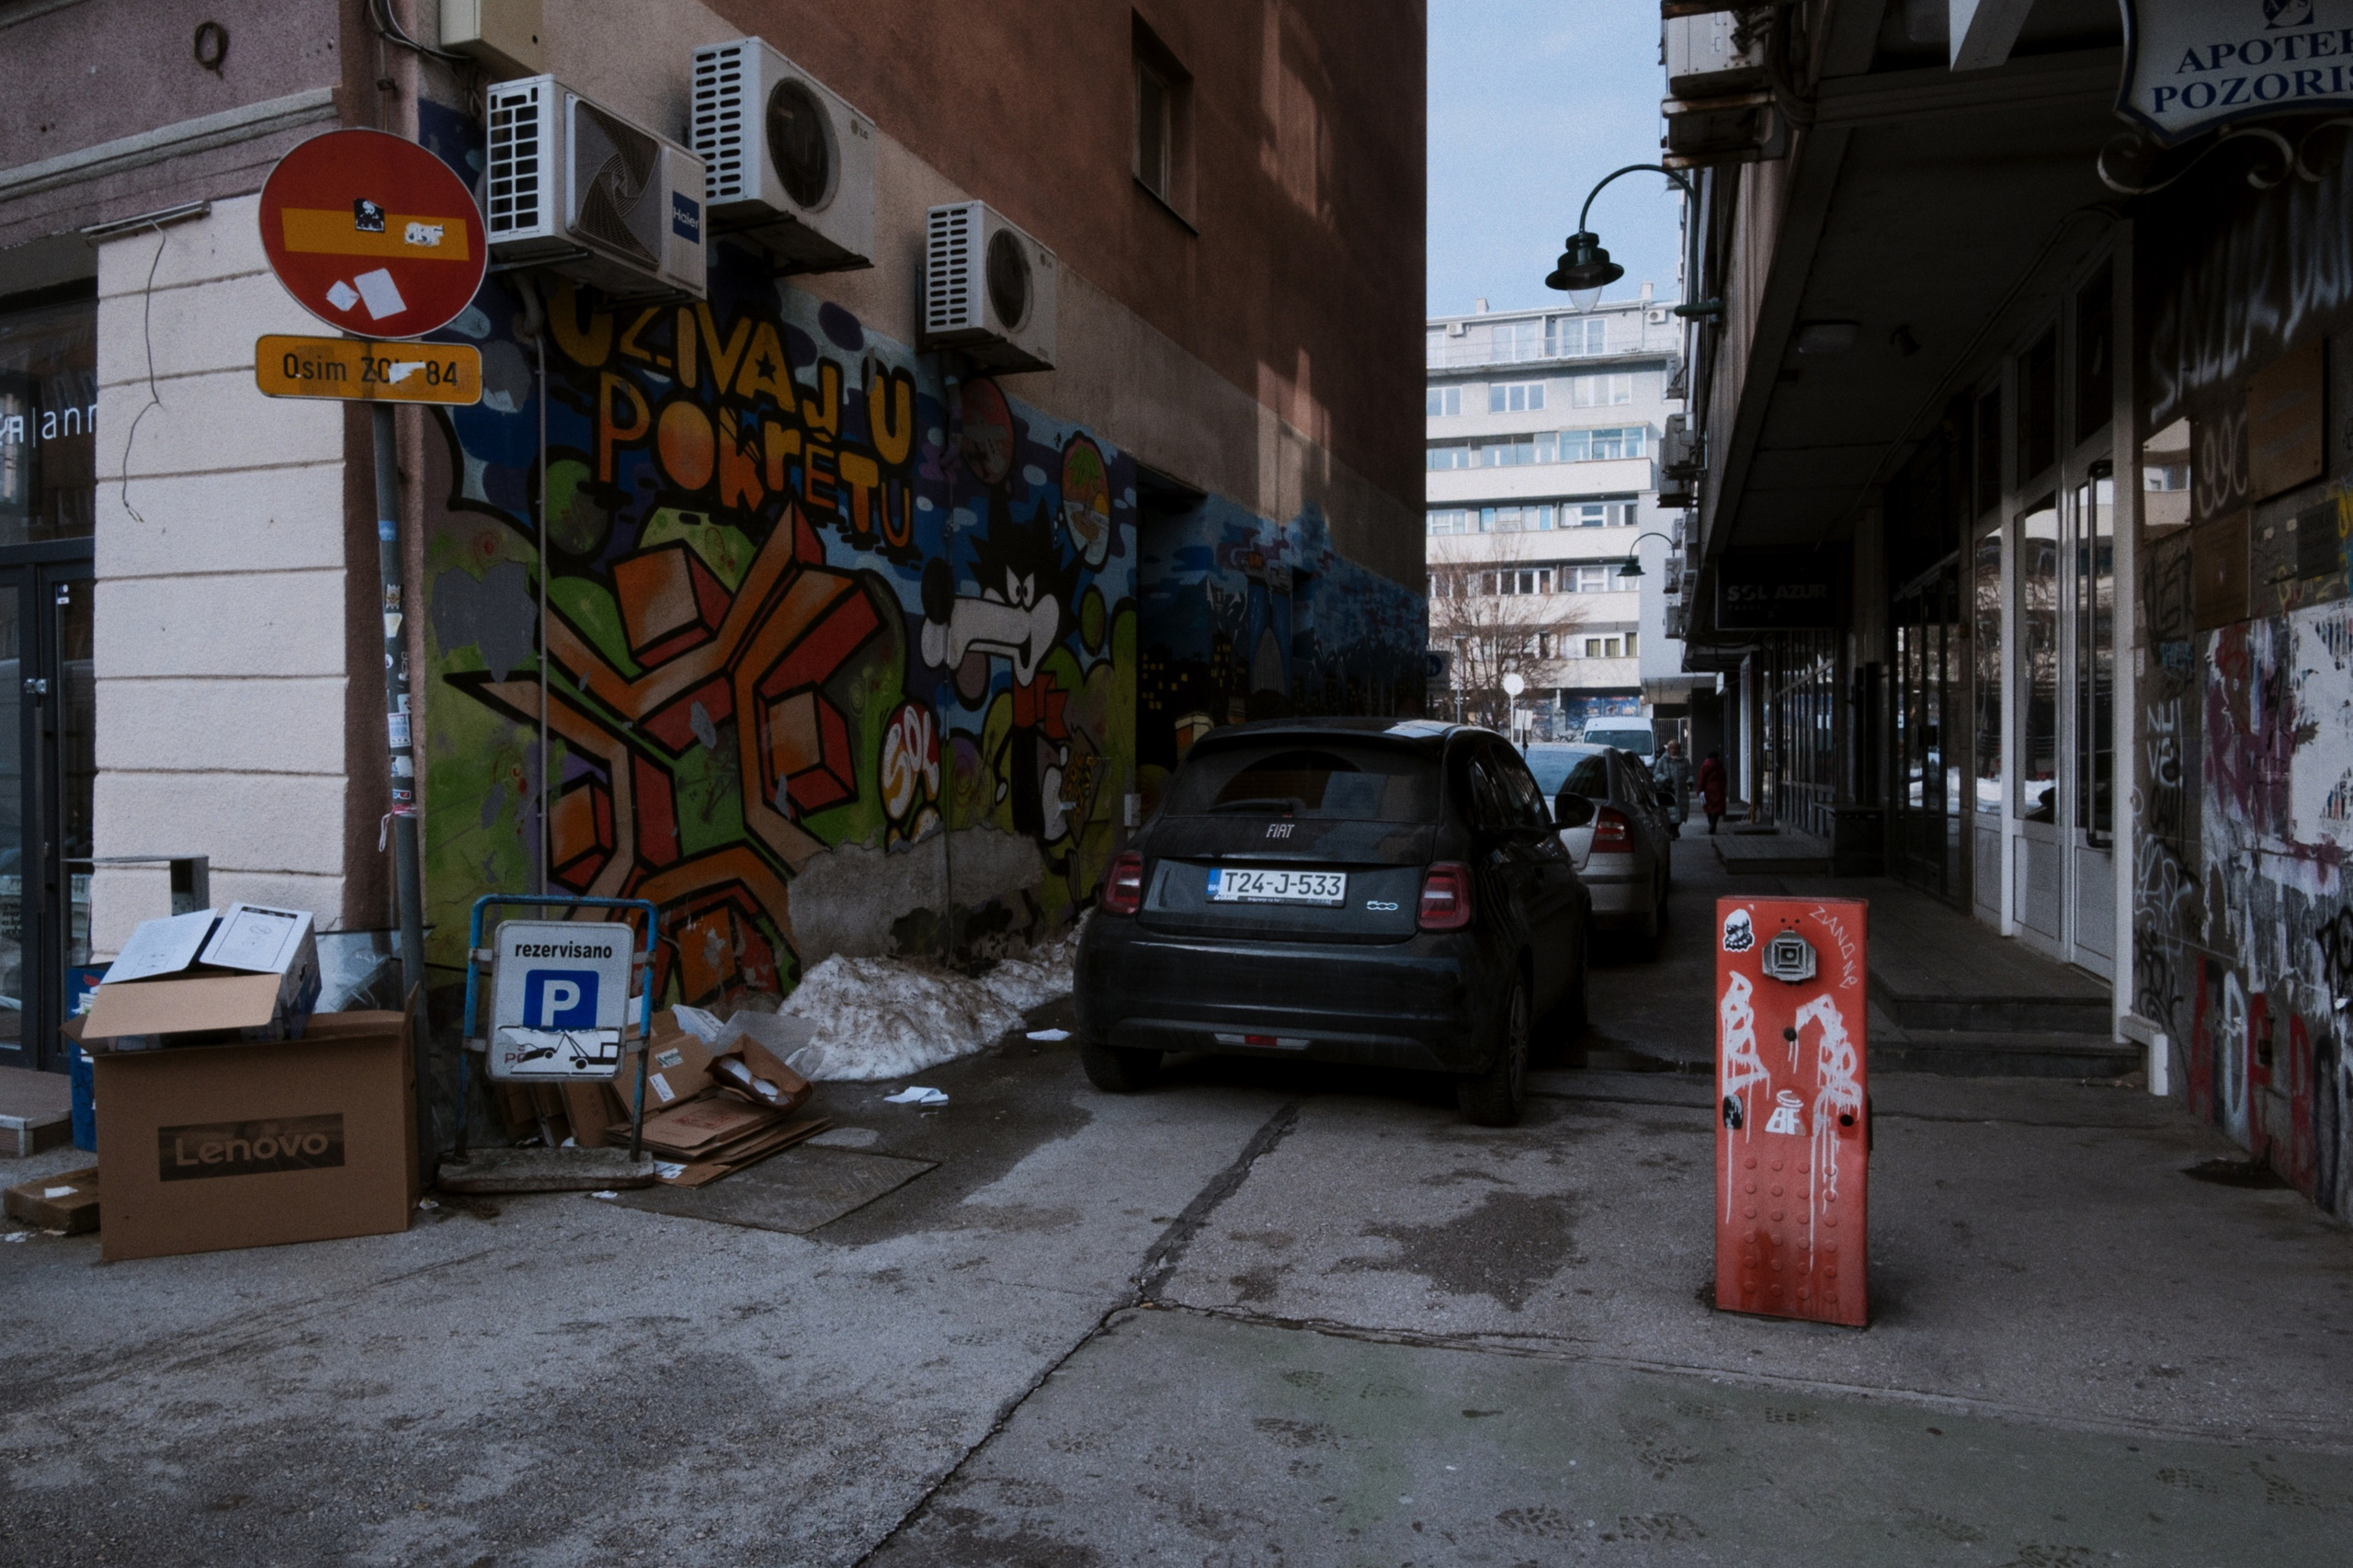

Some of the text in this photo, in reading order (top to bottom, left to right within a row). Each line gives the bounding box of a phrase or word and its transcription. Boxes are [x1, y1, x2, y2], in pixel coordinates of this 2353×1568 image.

[2152, 65, 2353, 114] POZORI
[673, 206, 699, 229] Haier
[282, 353, 347, 382] Osim
[1727, 583, 1828, 603] SOL AZUR
[1267, 824, 1295, 838] FIAT
[1225, 871, 1342, 897] T24-J-533
[1366, 900, 1399, 911] 500
[515, 941, 612, 959] rezervisano
[540, 979, 581, 1028] P
[175, 1132, 329, 1166] Lenovo
